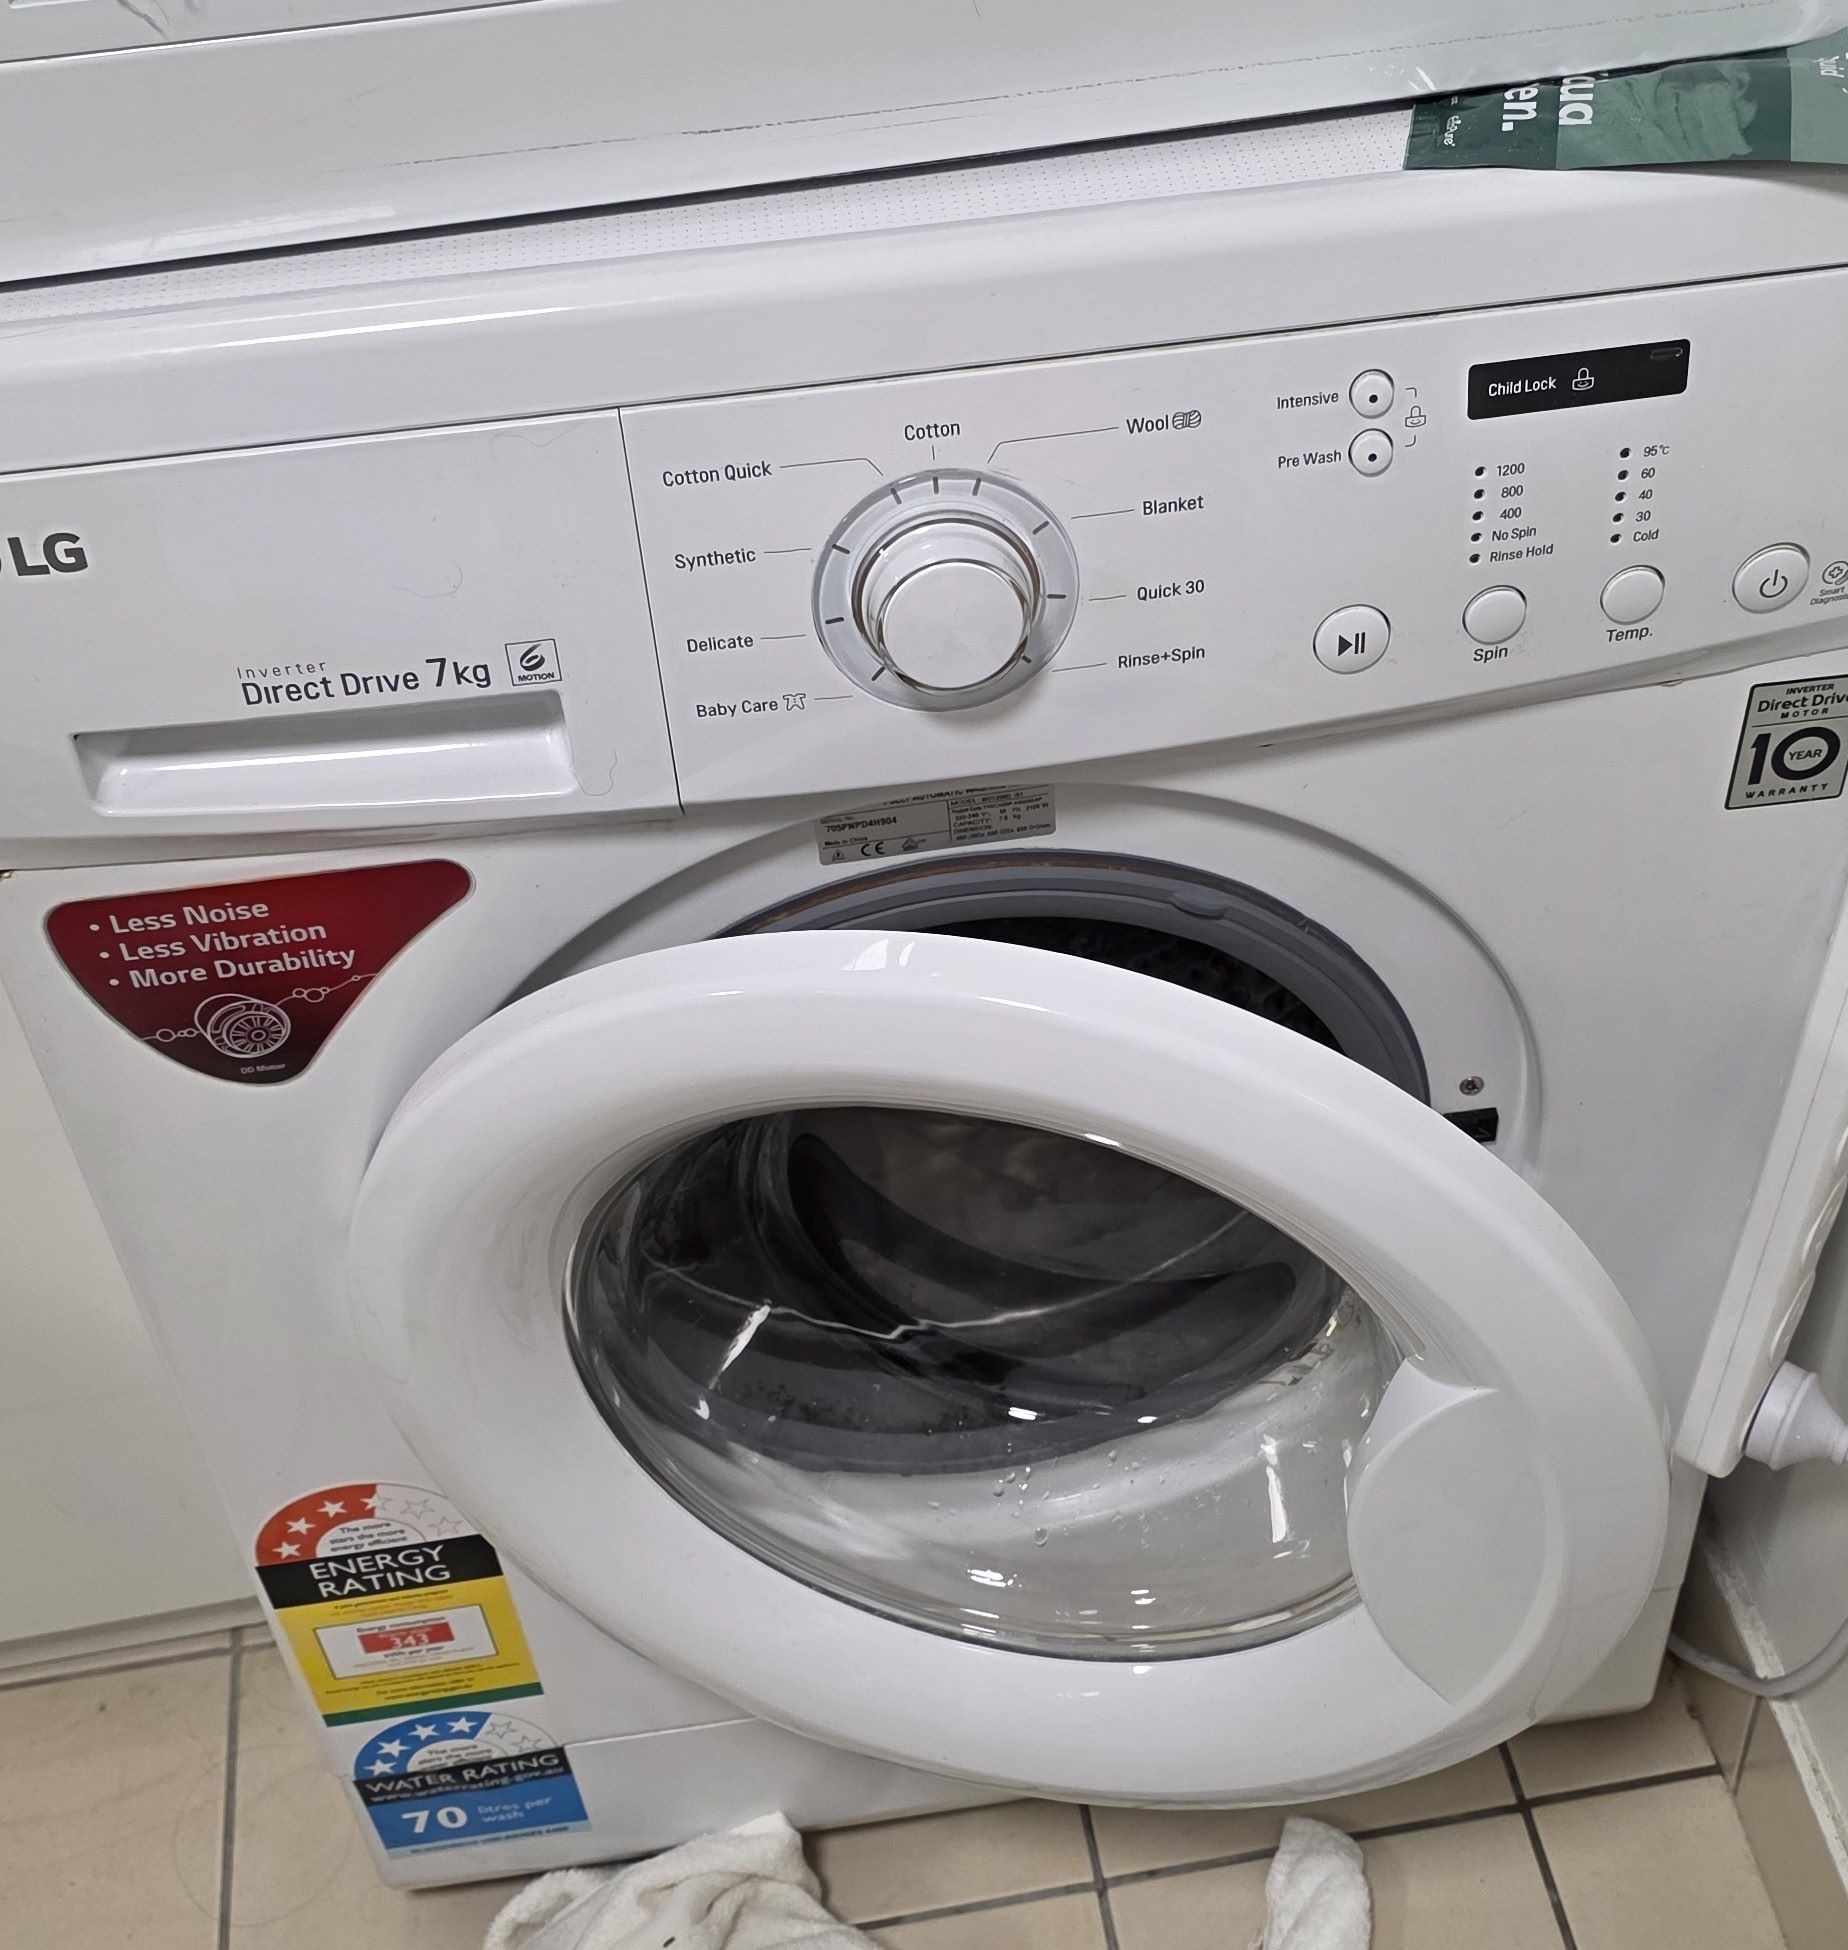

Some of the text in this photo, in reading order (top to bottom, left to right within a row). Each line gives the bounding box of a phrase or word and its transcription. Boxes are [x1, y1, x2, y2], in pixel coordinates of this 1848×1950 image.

[1488, 376, 1557, 397] Child Lock
[1277, 390, 1339, 409] Intensive
[904, 422, 961, 441] Cotton
[1126, 414, 1169, 434] Wool
[1278, 450, 1342, 468] Pre Wash
[662, 460, 773, 487] Cotton Quick
[1496, 462, 1525, 477] 1200
[1641, 467, 1656, 480] 60
[1501, 484, 1524, 498] 800
[1638, 489, 1653, 501] 40
[1142, 495, 1205, 516] Blanket
[1499, 506, 1522, 520] 400
[1635, 510, 1651, 523] 30
[1491, 526, 1537, 541] No Spin
[1633, 529, 1659, 543] Cold
[7, 532, 89, 577] LG
[674, 549, 757, 572] Synthetic
[1489, 543, 1554, 562] Rinse Hold
[1137, 579, 1205, 602] Quick 30
[686, 634, 754, 653] Delicate
[1606, 626, 1654, 643] Temp.
[1118, 645, 1206, 669] Rinse+Spin
[1473, 645, 1509, 664] Spin
[236, 660, 327, 680] Inverter
[518, 671, 555, 682] MOTION
[241, 677, 335, 706] Direct
[340, 670, 420, 697] Drive
[1786, 683, 1835, 695] INVERTER
[696, 698, 779, 718] Baby Care
[1758, 697, 1809, 712] Direct
[1780, 708, 1829, 719] MOTOR
[1747, 727, 1841, 785] 10
[1789, 749, 1823, 761] YEAR
[1745, 783, 1829, 798] WARRANTY
[109, 902, 270, 934] Less Noise
[119, 924, 328, 961] Less Vibration
[129, 949, 356, 989] More Durability
[308, 1544, 444, 1581] ENERGY
[317, 1564, 451, 1598] RATING
[366, 1774, 454, 1794] WATER
[462, 1754, 560, 1782] RATING
[476, 1797, 553, 1815] litres per
[401, 1806, 469, 1834] 70
[481, 1810, 525, 1823] wash
